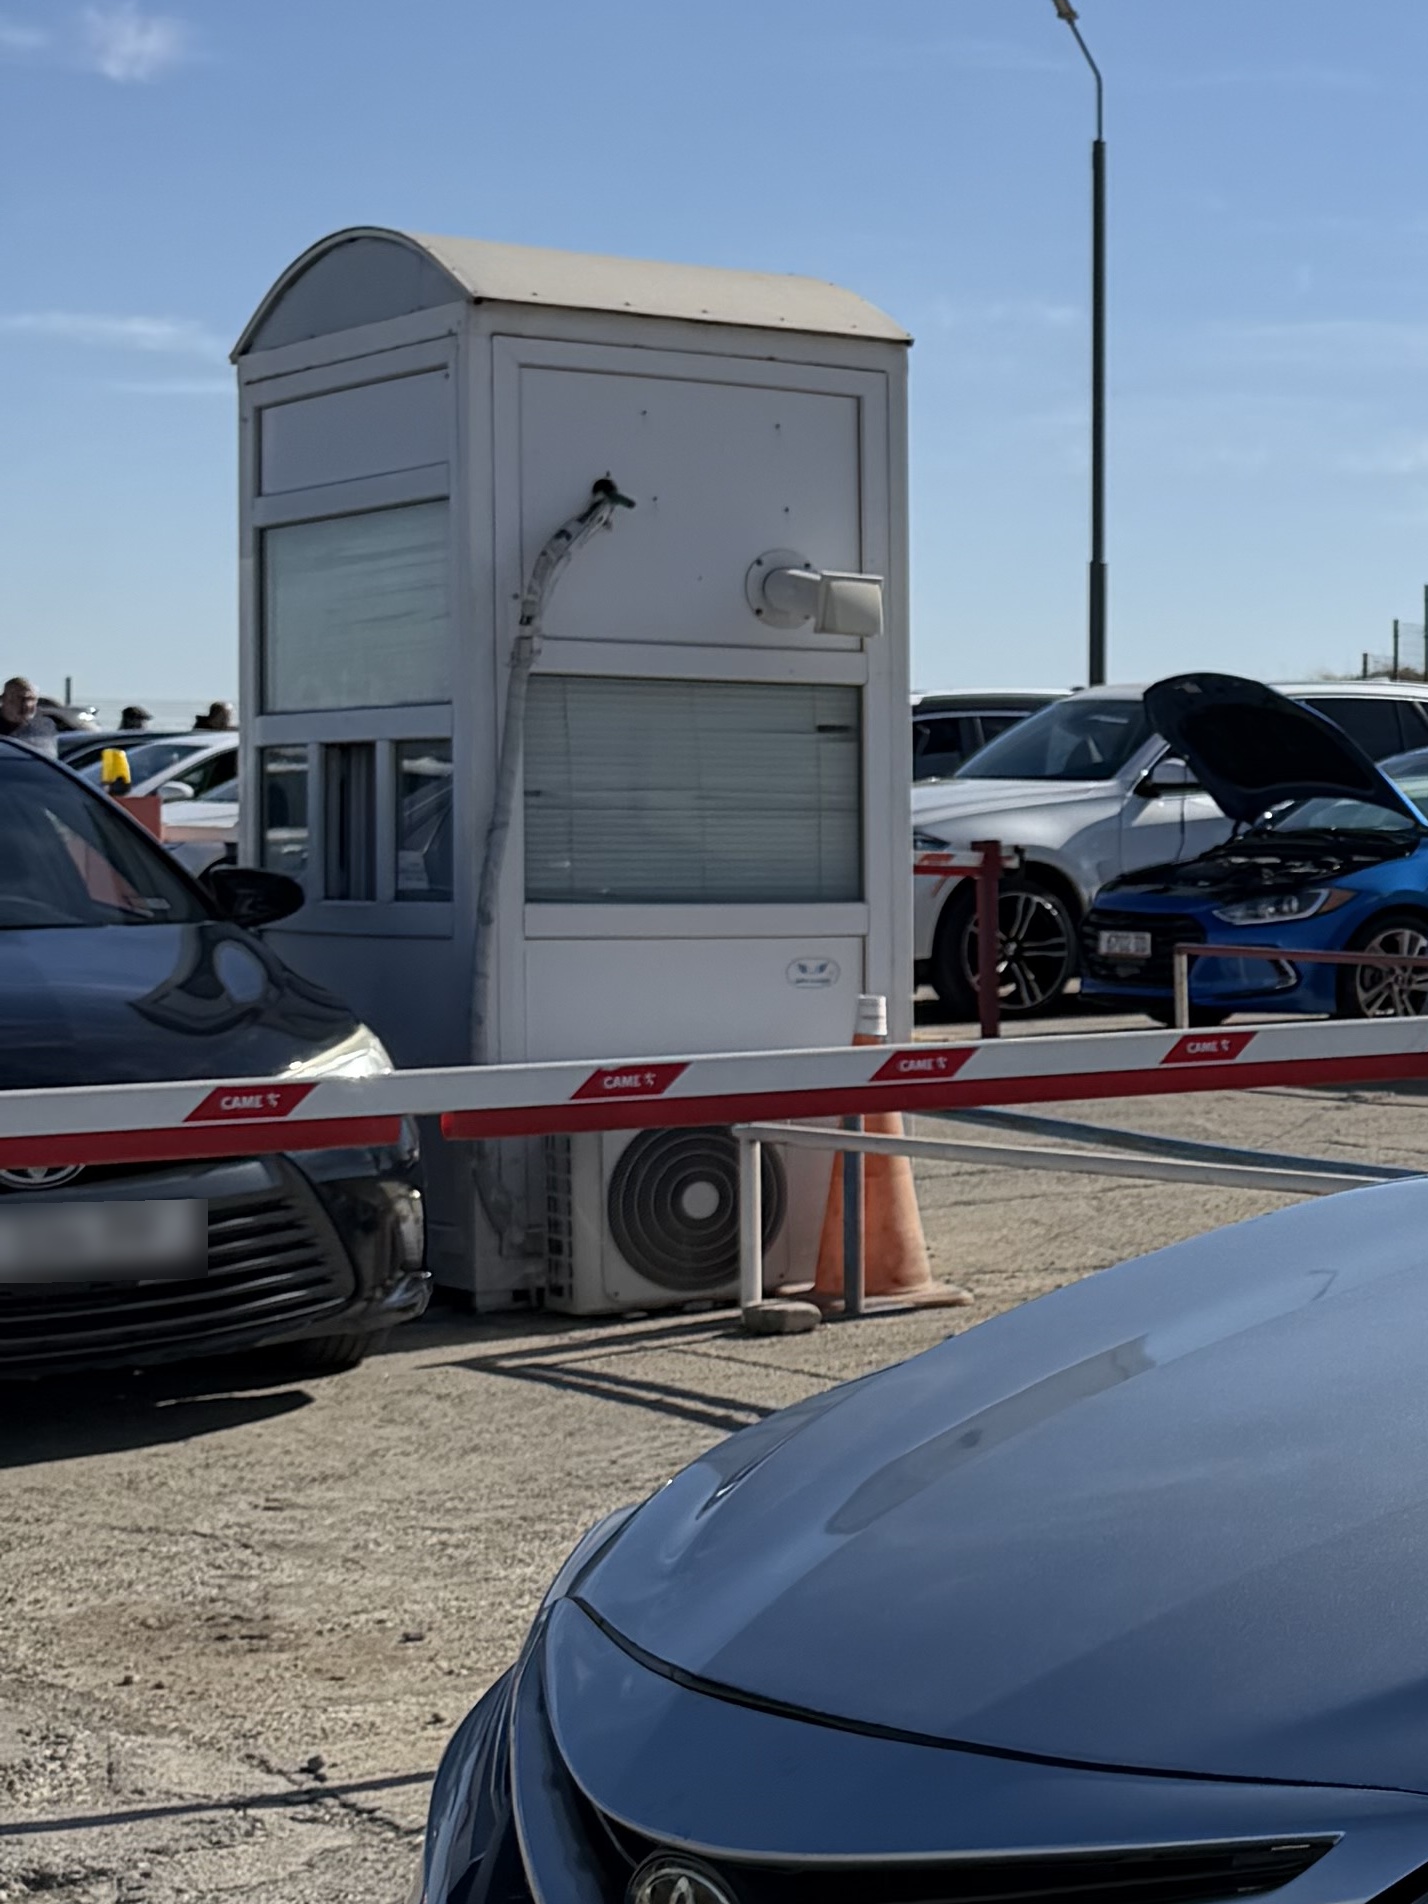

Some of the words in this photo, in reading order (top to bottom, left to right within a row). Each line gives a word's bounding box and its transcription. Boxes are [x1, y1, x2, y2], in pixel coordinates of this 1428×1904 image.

[1186, 1041, 1218, 1053] CAME
[897, 1058, 933, 1072] CAME
[603, 1075, 642, 1089] CAME
[220, 1095, 264, 1110] CAME
